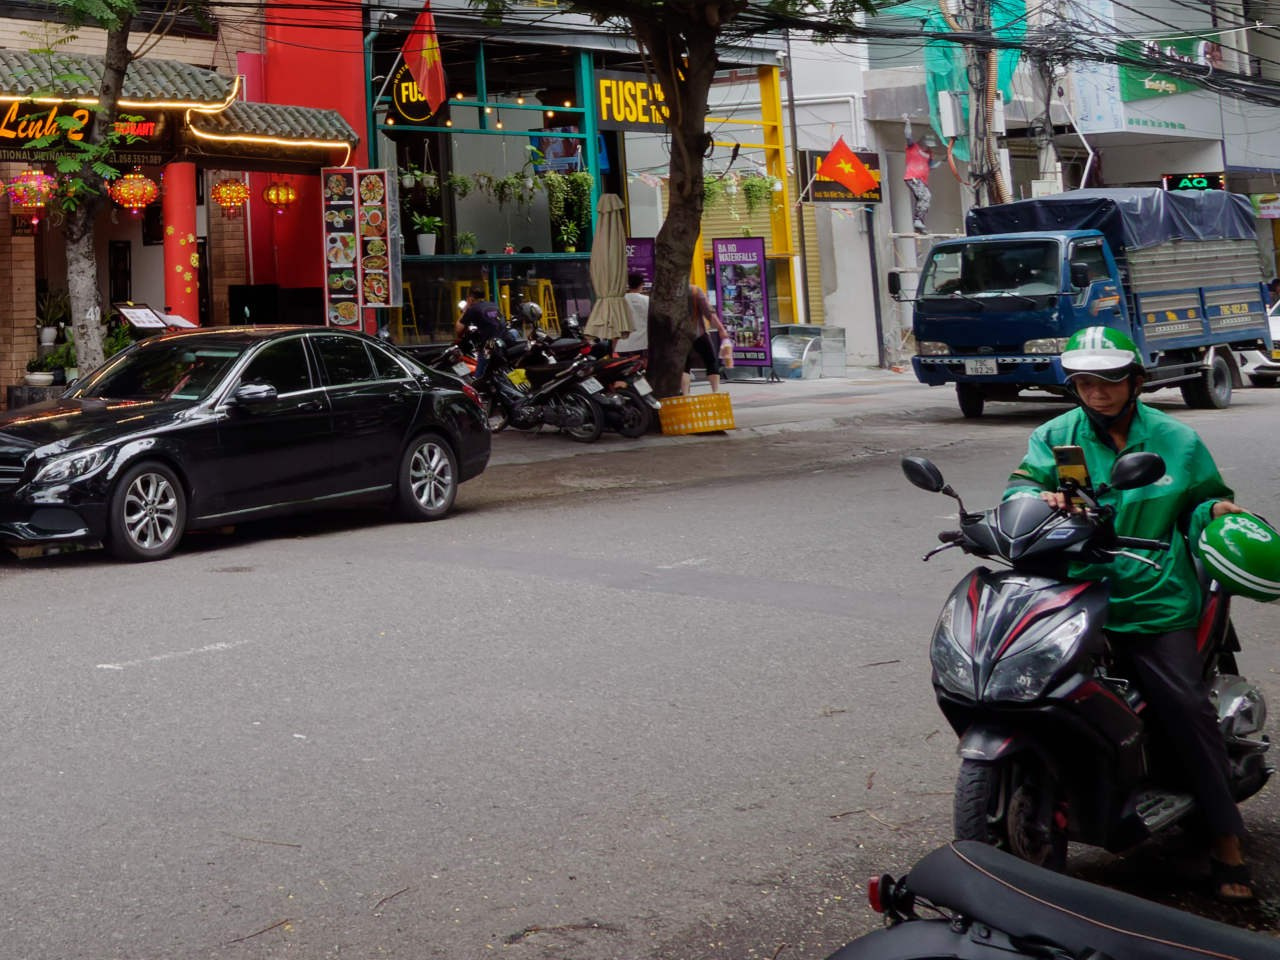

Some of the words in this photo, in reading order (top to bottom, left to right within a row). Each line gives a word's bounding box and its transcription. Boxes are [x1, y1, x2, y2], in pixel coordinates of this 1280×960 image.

[401, 82, 426, 103] FUS
[599, 79, 650, 123] FUSE
[1179, 179, 1208, 188] AQ
[626, 245, 635, 256] SE
[719, 253, 757, 261] WATERFALLS
